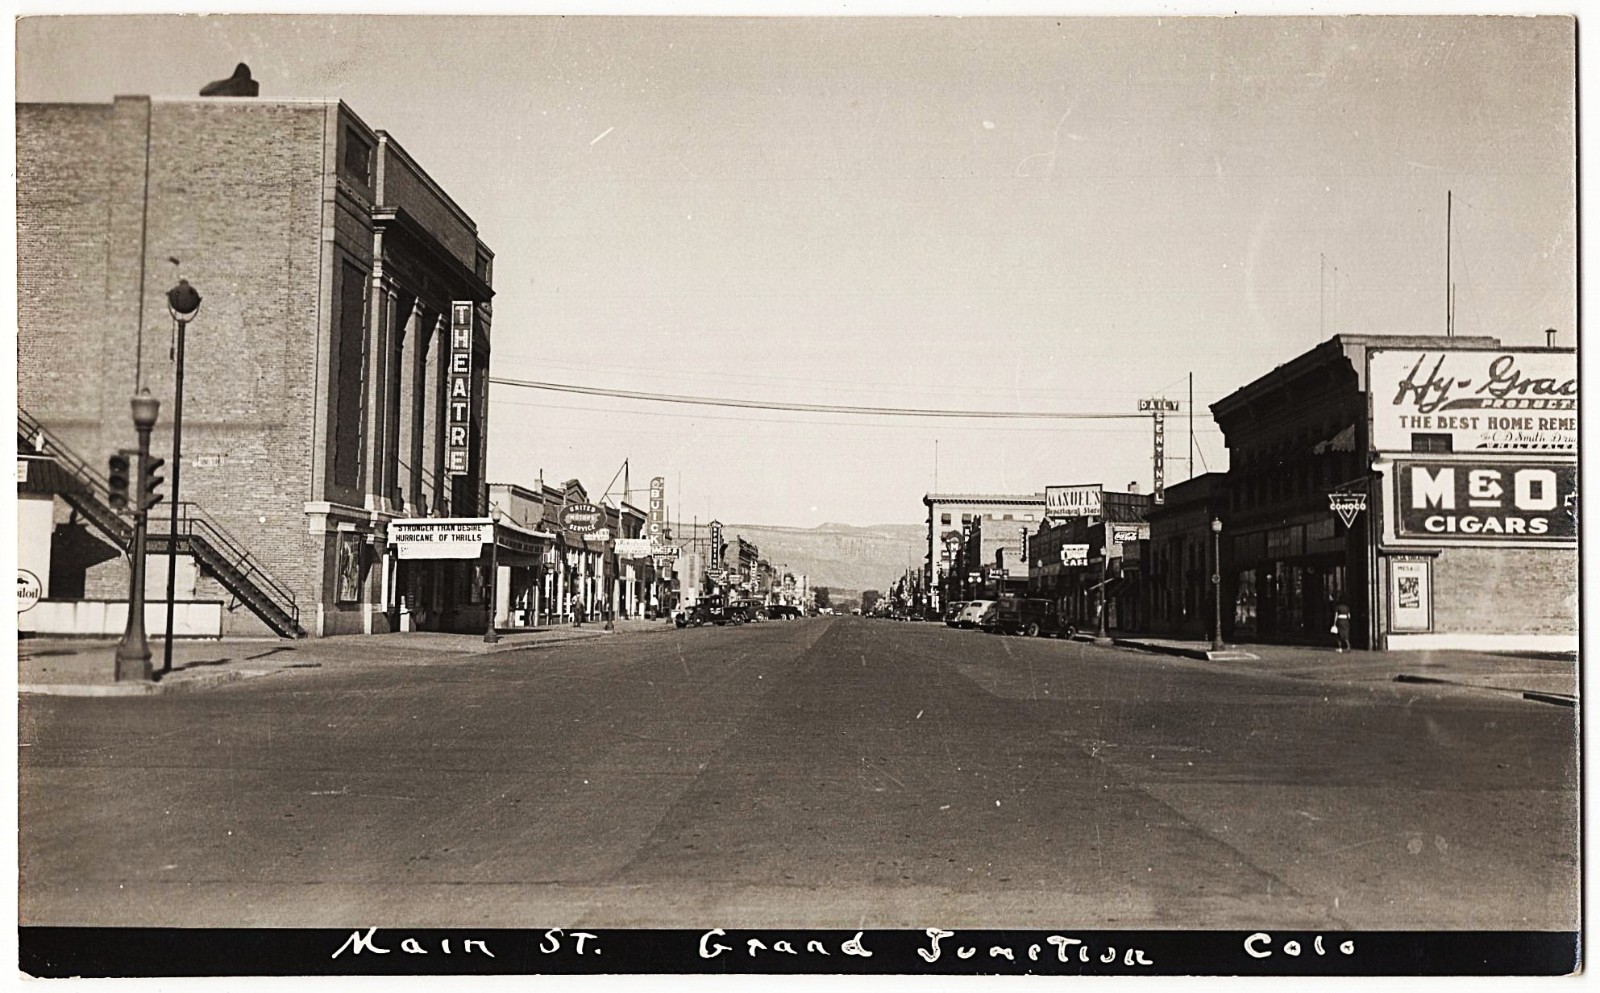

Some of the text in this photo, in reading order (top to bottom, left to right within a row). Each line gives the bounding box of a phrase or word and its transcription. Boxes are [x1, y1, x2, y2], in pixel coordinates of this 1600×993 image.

[450, 304, 470, 471] THEATRE
[1141, 400, 1178, 410] DAILY
[1399, 415, 1432, 429] THE
[1437, 416, 1480, 430] BEST
[1487, 417, 1533, 430] HOME
[1155, 413, 1164, 502] SENTINEL
[569, 504, 596, 513] UNITED
[1329, 503, 1367, 511] CONOCO
[650, 489, 660, 544] BUICK
[569, 523, 596, 532] SERVICE
[1424, 515, 1550, 535] CIGARS
[395, 534, 482, 542] HURRICANE OF THRILLS
[1063, 559, 1089, 567] CAFE
